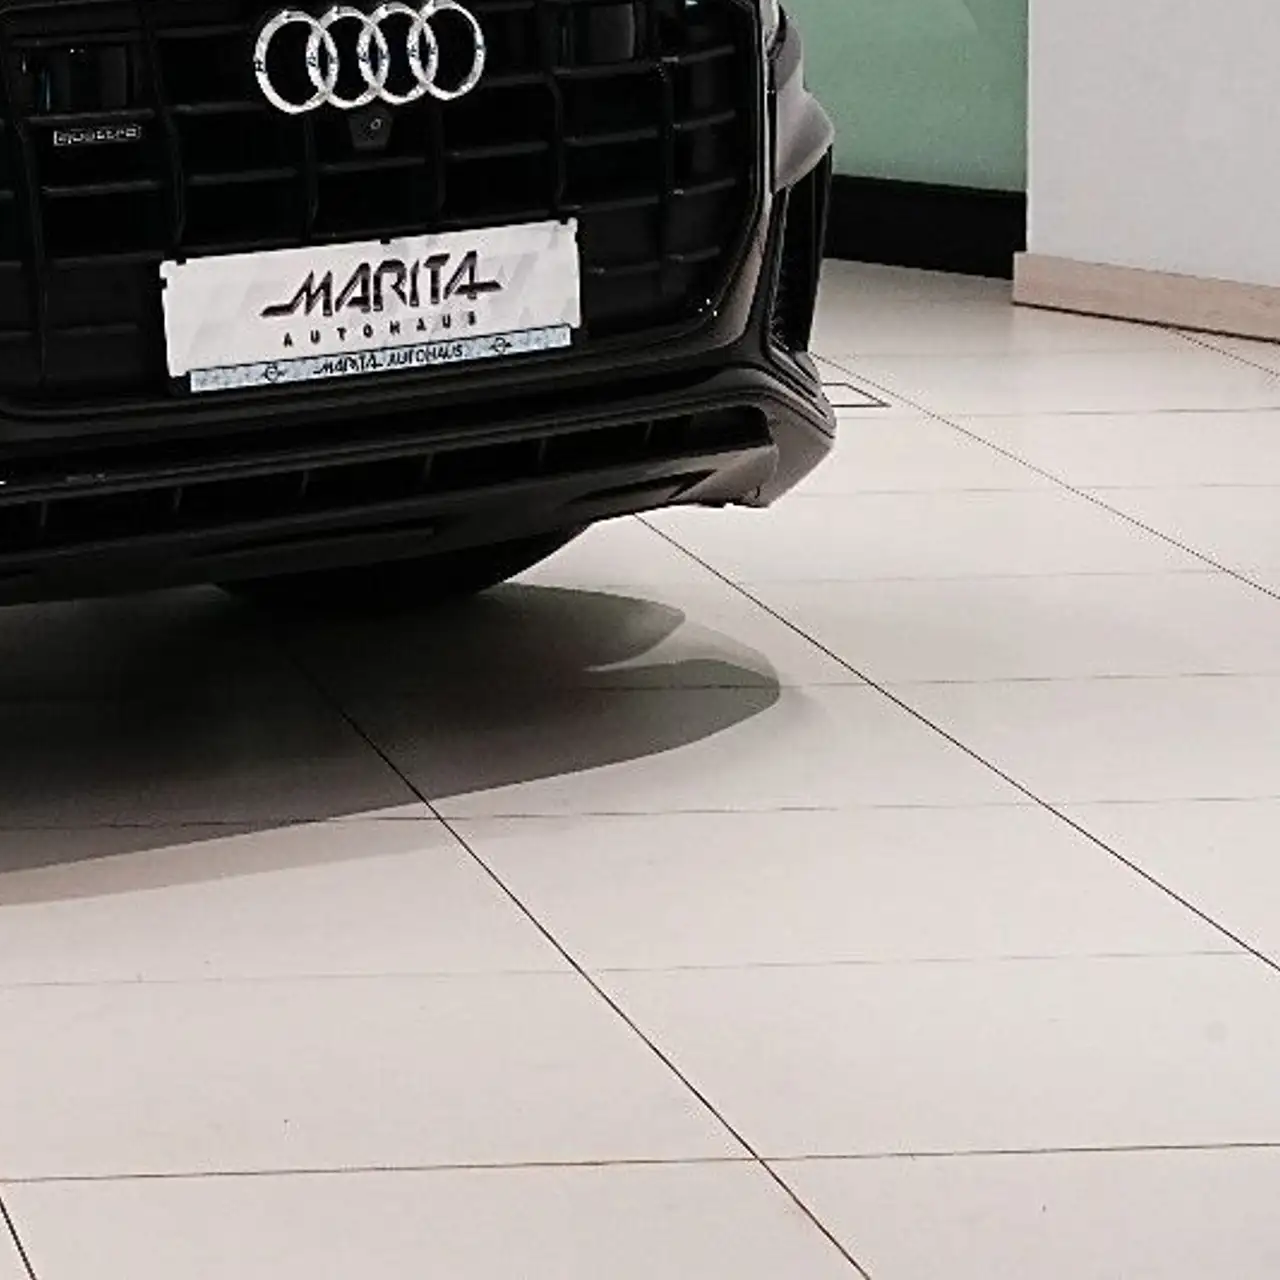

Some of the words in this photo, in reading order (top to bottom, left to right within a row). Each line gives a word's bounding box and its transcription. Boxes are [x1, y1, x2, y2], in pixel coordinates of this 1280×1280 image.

[260, 249, 502, 318] MARITA
[283, 311, 477, 347] AUTOHAUS
[313, 351, 386, 375] MARITA
[387, 344, 464, 368] AUTOHAUS
